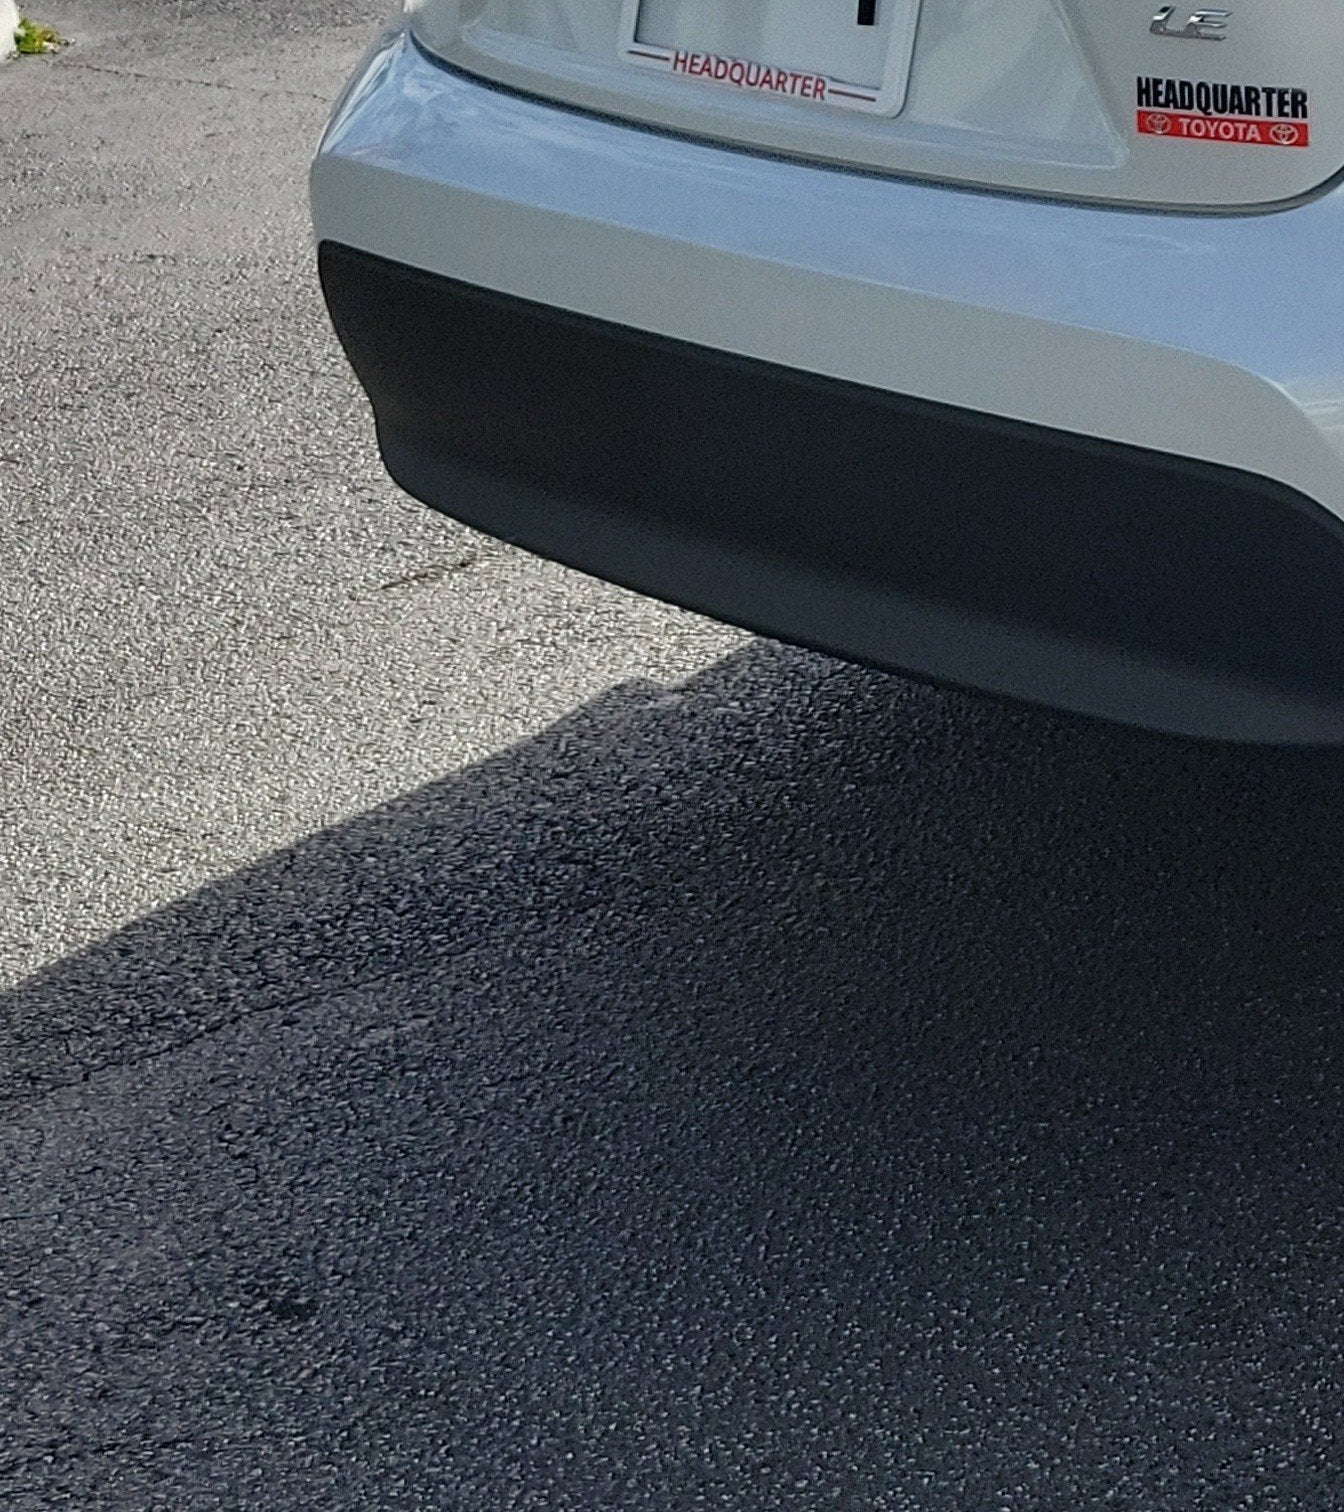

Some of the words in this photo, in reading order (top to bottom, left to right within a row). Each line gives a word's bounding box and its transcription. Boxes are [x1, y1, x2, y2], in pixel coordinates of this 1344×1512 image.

[1149, 4, 1234, 42] LE
[672, 50, 828, 101] HEADQUARTER
[1136, 75, 1309, 120] HEADQUARTER
[1177, 117, 1263, 142] TOYOTA
